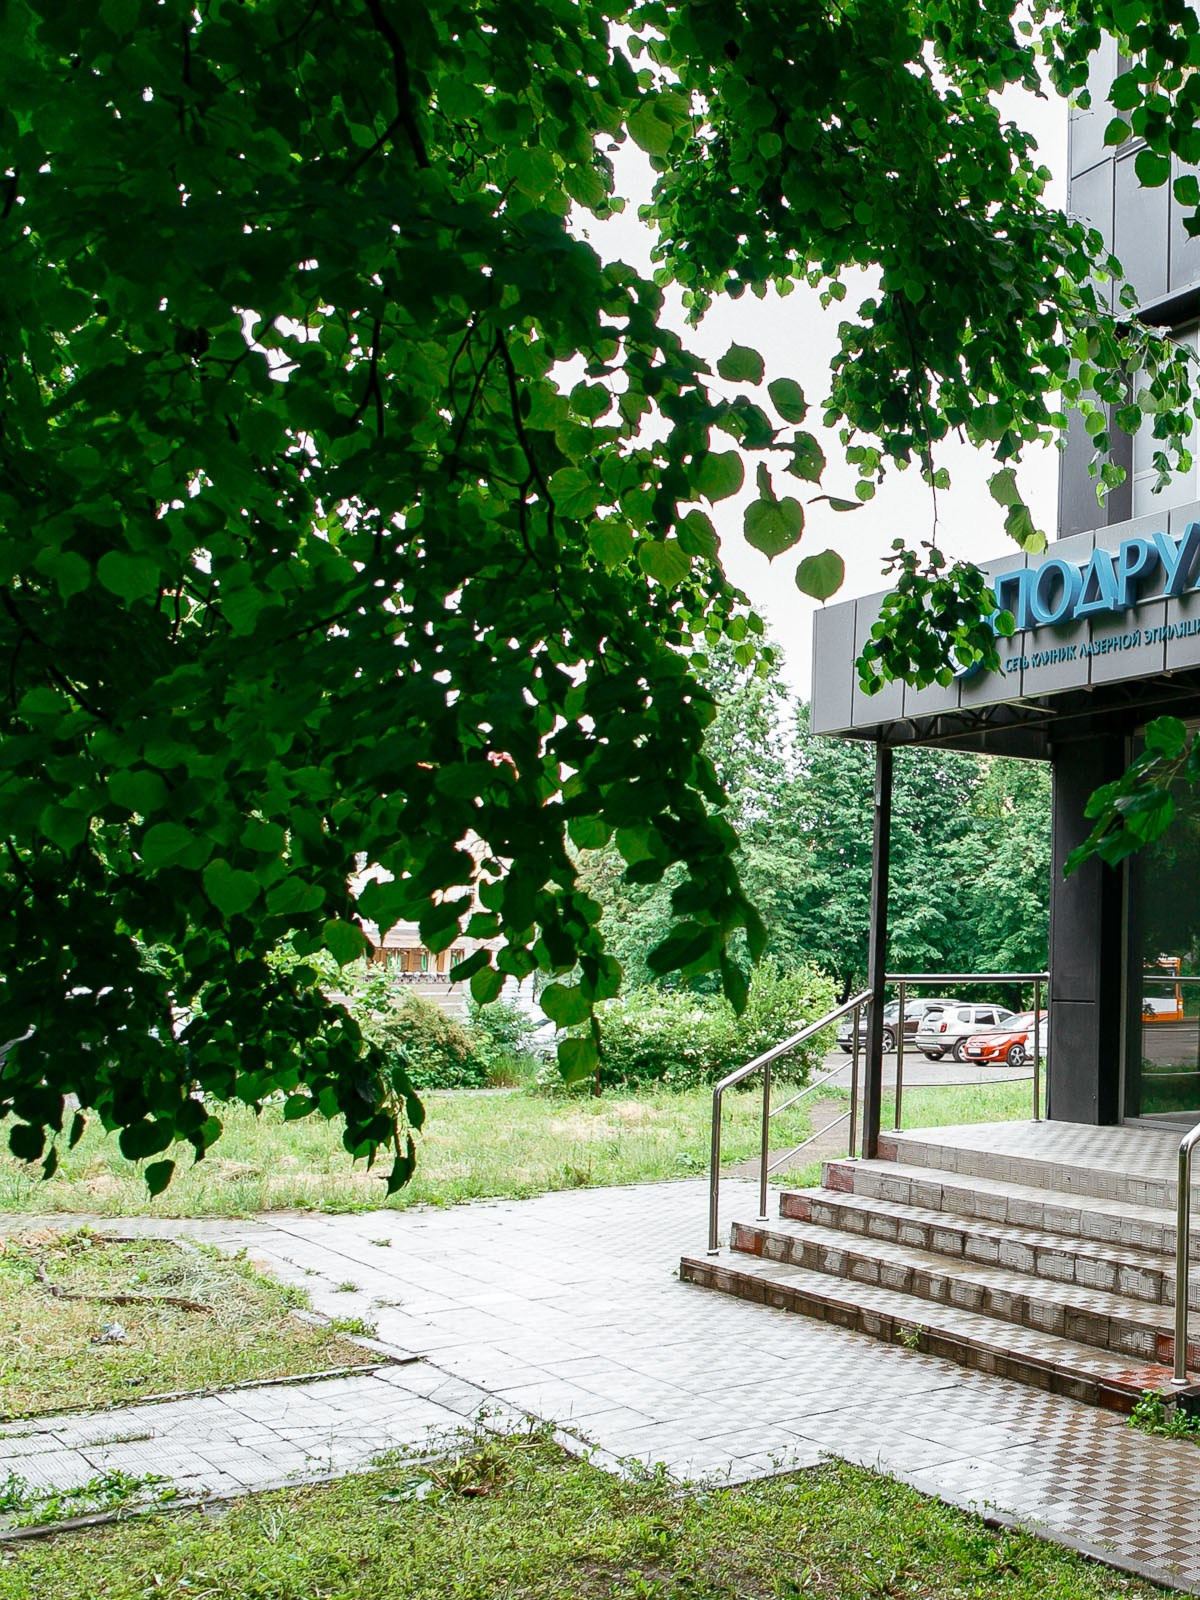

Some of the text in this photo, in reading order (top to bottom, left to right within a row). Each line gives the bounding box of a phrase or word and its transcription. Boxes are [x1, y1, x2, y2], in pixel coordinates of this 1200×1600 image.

[1005, 655, 1030, 673] СЕТЬ
[1031, 645, 1077, 668] КЛИНИК
[1080, 629, 1142, 657] ЛАЗЕРНОЙ
